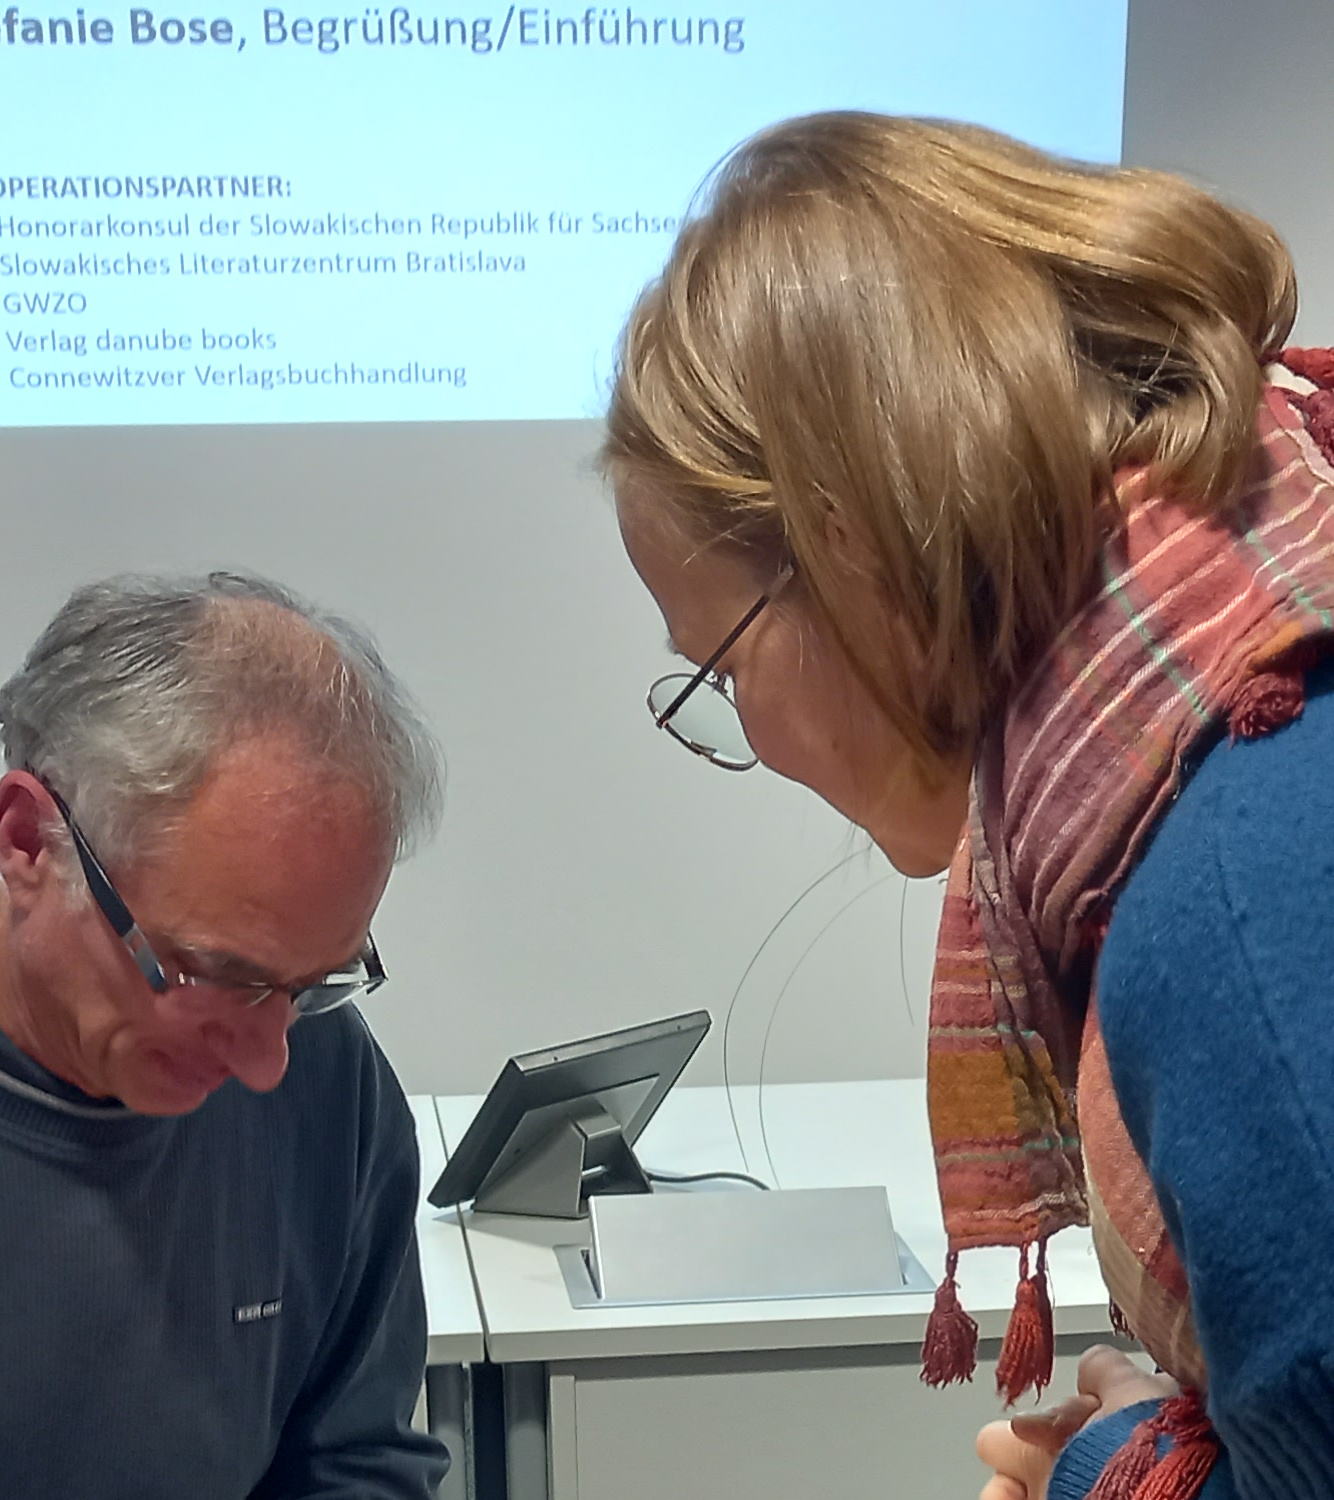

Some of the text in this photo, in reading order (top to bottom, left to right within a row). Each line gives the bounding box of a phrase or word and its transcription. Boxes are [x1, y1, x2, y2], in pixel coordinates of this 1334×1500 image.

[130, 7, 247, 53] Bose,
[263, 4, 746, 54] Begrüßung/Einführung
[199, 213, 241, 237] der
[250, 211, 422, 237] Slowakischen
[432, 210, 539, 239] Republik
[548, 210, 584, 235] für
[0, 250, 527, 276] Slowakisches Literaturzentrum Bratislava
[2, 291, 87, 315] GWZO
[6, 327, 277, 357] Verlag danube books
[9, 361, 467, 391] Connewitzver Verlagsbuchhandlung
